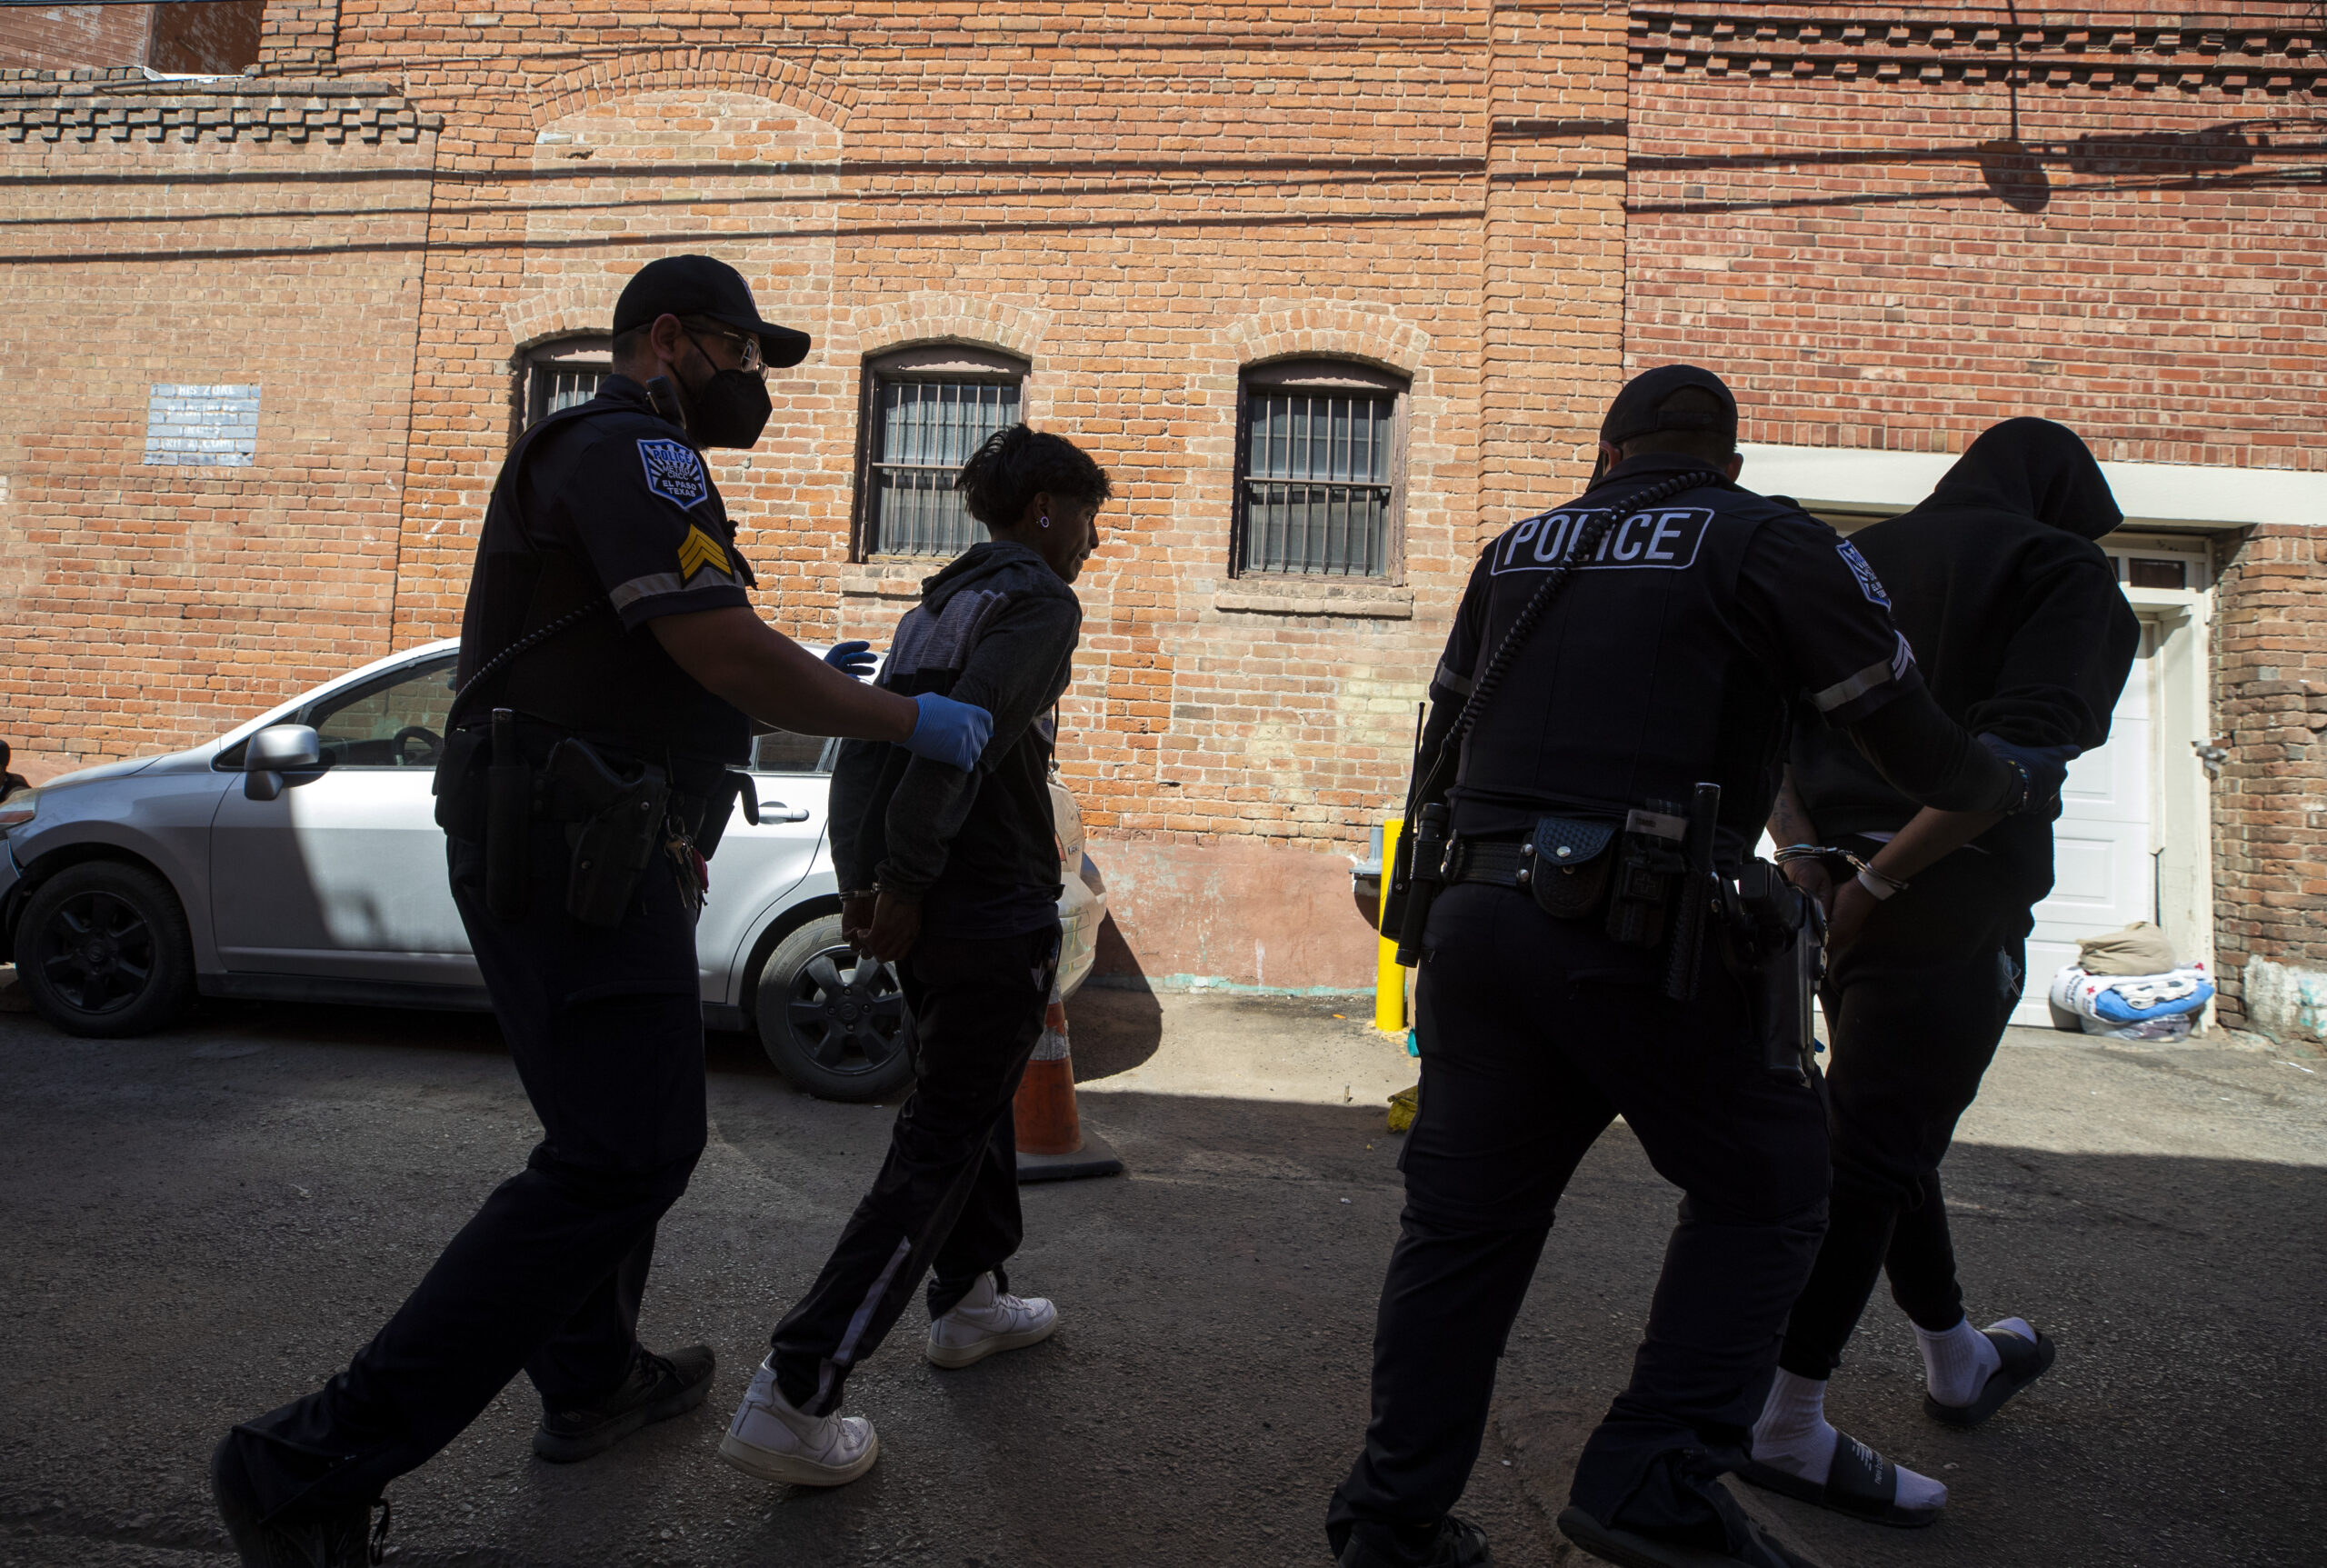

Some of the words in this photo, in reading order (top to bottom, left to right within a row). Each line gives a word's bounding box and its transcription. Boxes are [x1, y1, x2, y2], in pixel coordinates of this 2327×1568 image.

[175, 385, 197, 395] HIS
[653, 449, 692, 464] POLICE
[675, 481, 696, 491] PASO
[666, 487, 696, 497] TEXAS
[1503, 513, 1692, 566] POLICE
